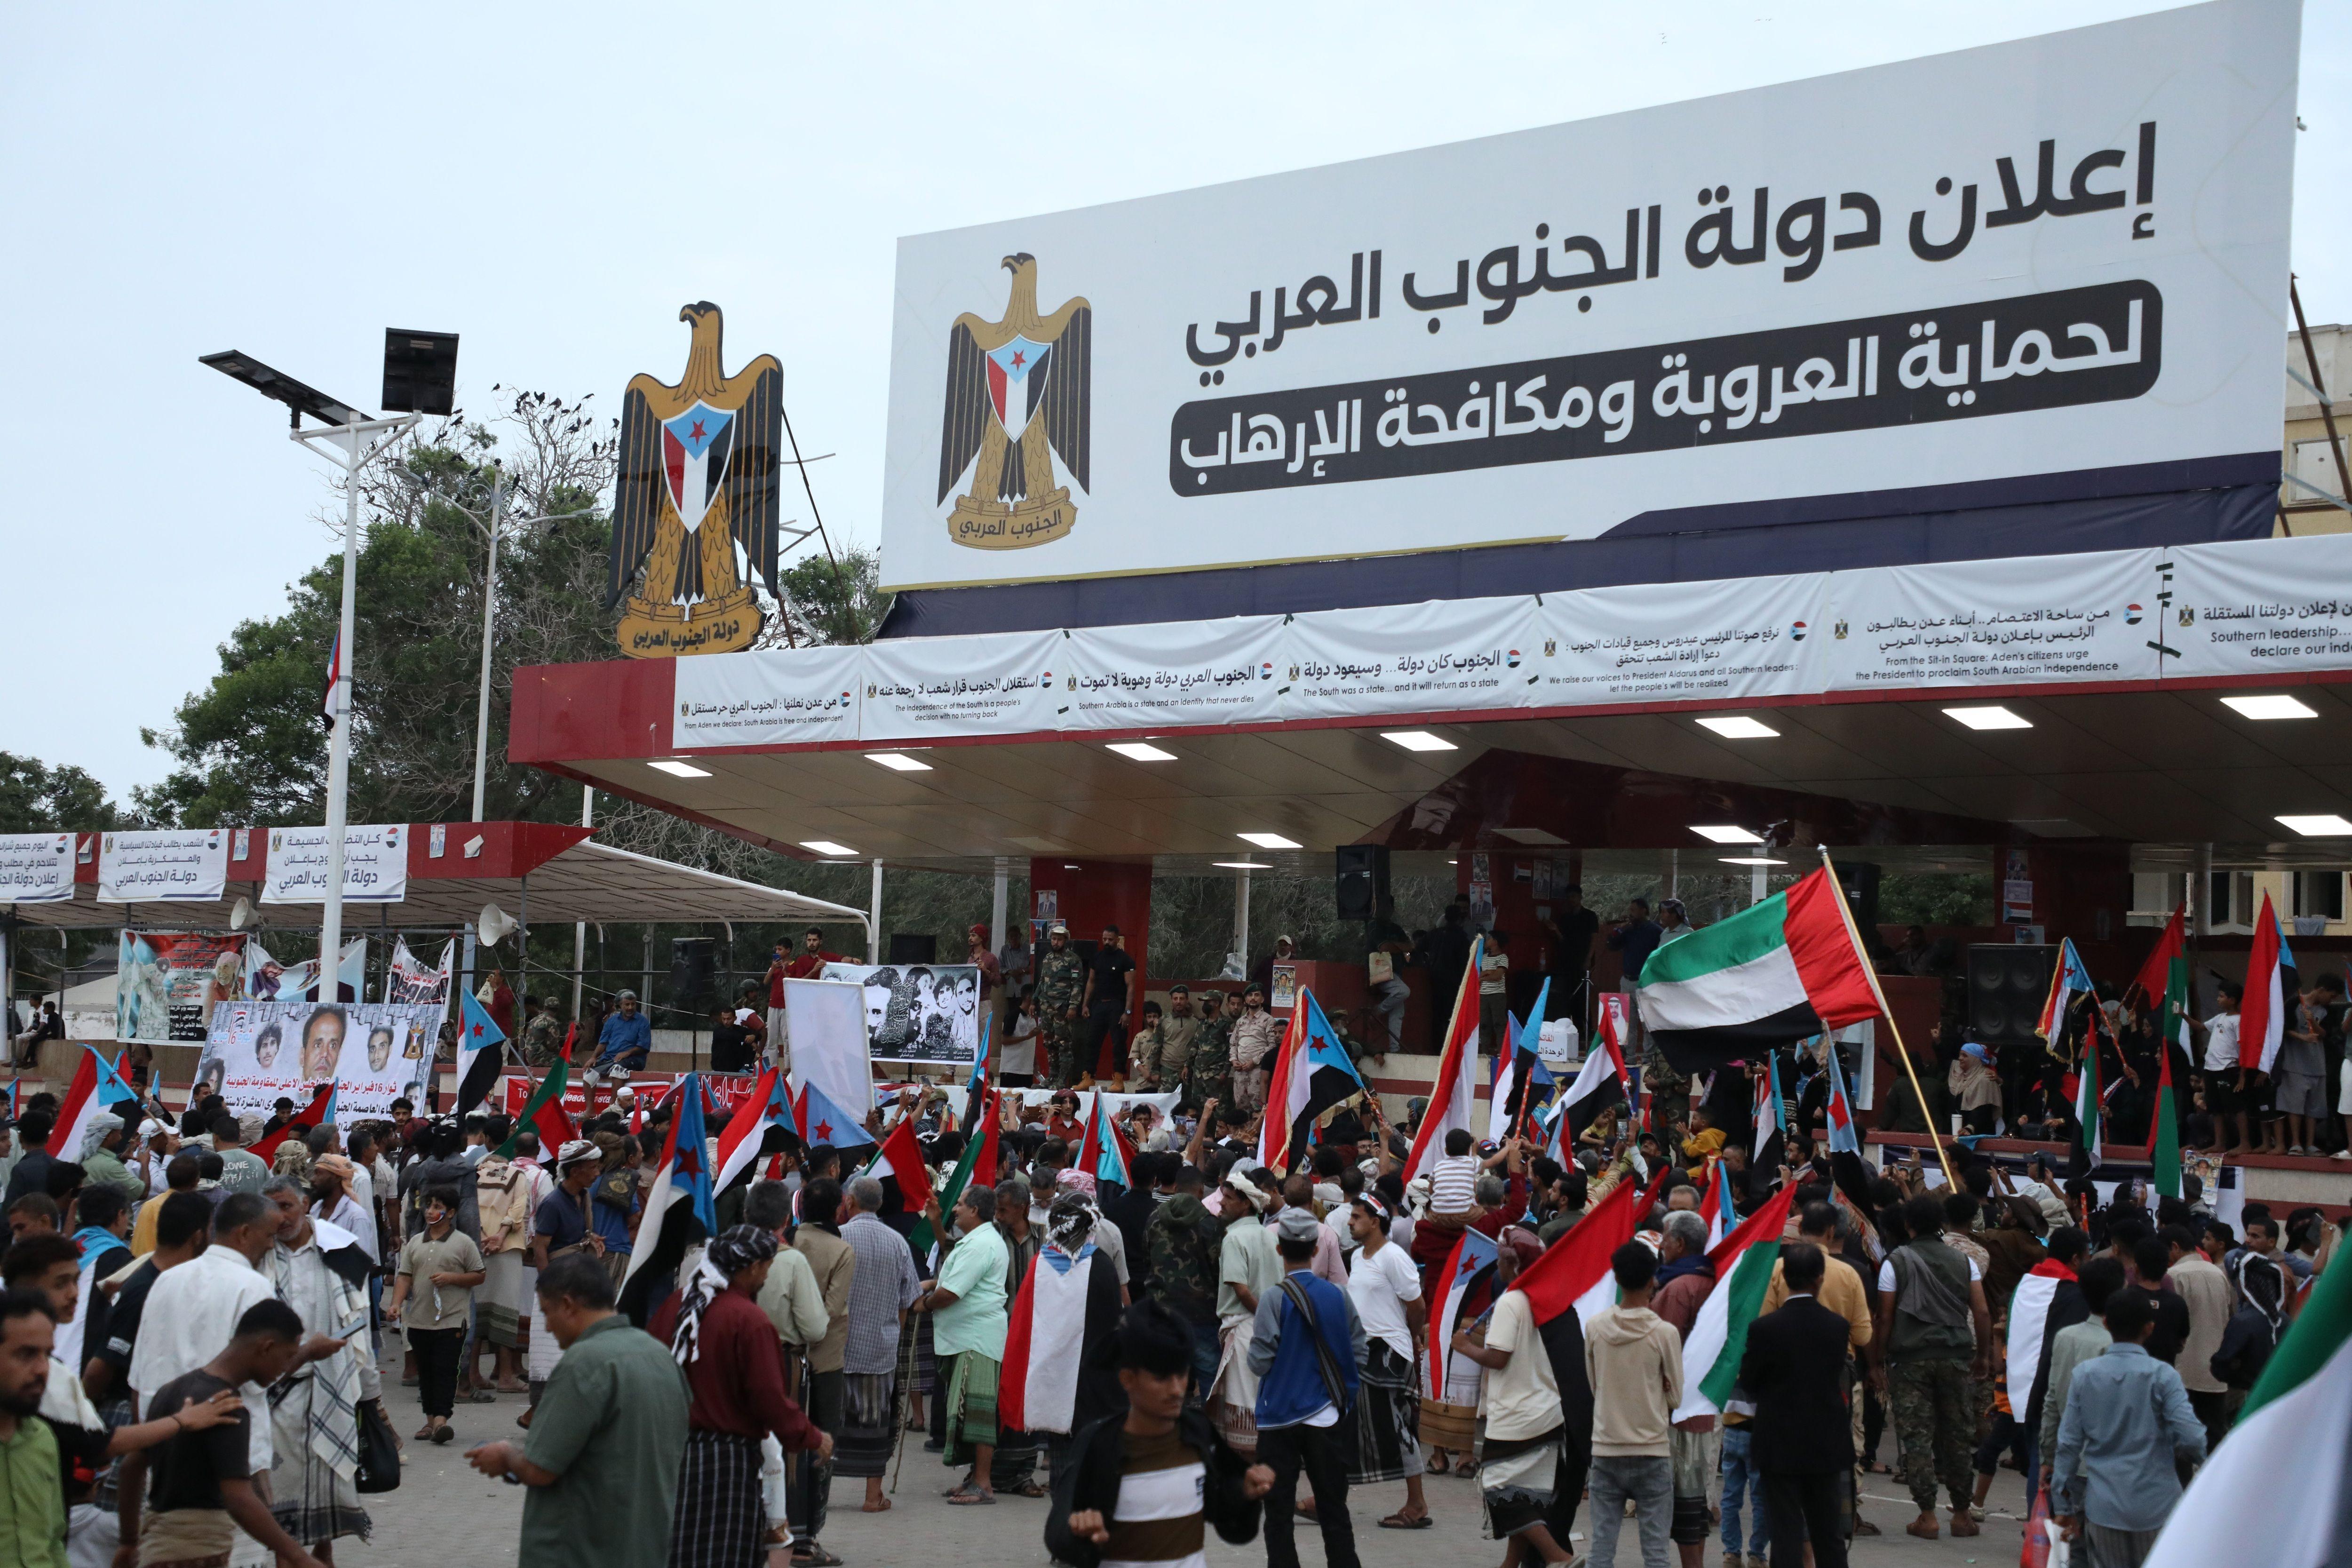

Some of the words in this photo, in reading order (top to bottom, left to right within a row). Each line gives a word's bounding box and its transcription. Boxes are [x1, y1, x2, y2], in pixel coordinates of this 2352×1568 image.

[1908, 121, 2156, 262] إعلان
[1685, 185, 1882, 282] دولة
[1402, 204, 1661, 334] الجنوب
[1185, 249, 1382, 386] العربي
[1898, 299, 2143, 407] لحماية
[1652, 335, 1879, 434] العروبة
[1376, 374, 1635, 447] ومكافحة
[1180, 398, 1361, 485] الإرهاب
[959, 519, 1006, 539] العربي
[1011, 508, 1062, 540] الجنوب
[2046, 608, 2083, 621] ساحة
[2086, 610, 2110, 622] من
[2203, 605, 2255, 620] المستقلة
[2259, 604, 2295, 620] دولتنا
[2298, 600, 2338, 619] لإعلان
[1867, 617, 1916, 632] يطالبون
[1919, 618, 1946, 629] عدن
[1949, 610, 1975, 628] أبناء
[1986, 610, 2043, 625] الاعتصام
[712, 619, 739, 642] دولة
[1700, 630, 1732, 645] للرئيس
[1734, 630, 1759, 643] صوتنا
[1762, 626, 1780, 643] نرفع
[1972, 631, 1999, 645] دولة
[2001, 629, 2042, 645] بإعلان
[2046, 625, 2094, 643] الرئيس
[2210, 630, 2266, 643] Southern
[633, 628, 669, 649] العربي
[670, 625, 710, 653] الجنوب
[1571, 639, 1601, 653] الجنوب
[1603, 636, 1631, 650] قيادات
[1633, 639, 1660, 651] وجميع
[1662, 636, 1698, 648] عيدروس
[1879, 634, 1921, 653] العربي
[1924, 631, 1969, 648] الجنوب
[1646, 650, 1677, 665] الشعب
[1679, 649, 1699, 663] إرادة
[1701, 649, 1720, 662] دعوا
[1886, 658, 1908, 666] From
[1910, 656, 1924, 665] the
[1928, 655, 1950, 664] Sit-in
[1953, 654, 1988, 665] Square:
[1991, 652, 2025, 661] Aden's
[2027, 651, 2063, 660] citizens
[2066, 651, 2089, 660] urge
[2250, 645, 2301, 657] declare
[2305, 645, 2326, 654] our
[1427, 653, 1453, 674] كان
[1453, 650, 1500, 673] الجنوب
[1616, 653, 1645, 667] تتحقق
[1214, 665, 1255, 686] الجنوب
[1304, 661, 1330, 681] دولة
[1334, 662, 1382, 680] وسيعود
[1632, 671, 1667, 680] President
[1669, 668, 1697, 677] Aidarus
[1728, 666, 1763, 675] Southern
[1764, 664, 1794, 672] leaders
[1856, 671, 1870, 680] the
[1873, 669, 1916, 679] President
[1928, 668, 1971, 679] proclaim
[1973, 666, 1999, 676] South
[2002, 664, 2041, 675] Arabian
[2044, 662, 2119, 674] independence
[969, 677, 1001, 695] الجنوب
[1002, 675, 1038, 692] استقلال
[1081, 674, 1109, 692] تموت
[1112, 672, 1119, 686] لا
[1121, 672, 1151, 691] وهوية
[1154, 671, 1178, 688] دولة
[1180, 669, 1212, 692] العربي
[1635, 683, 1668, 692] people's
[1696, 679, 1728, 688] realized
[879, 686, 894, 696] عنه
[895, 683, 915, 699] رجعة
[918, 682, 924, 695] لا
[926, 681, 950, 698] شعب
[952, 678, 967, 696] قرار
[1304, 688, 1317, 697] The
[1319, 687, 1339, 696] South
[1366, 685, 1392, 693] state...
[1394, 683, 1410, 692] and
[1419, 682, 1431, 690] will
[1434, 681, 1456, 689] return
[1478, 678, 1499, 687] state
[691, 703, 717, 716] مستقل
[718, 704, 728, 715] حر
[729, 700, 749, 717] العربي
[751, 699, 777, 714] الجنوب
[784, 697, 803, 711] نعلنها
[805, 700, 823, 711] عدن
[824, 699, 837, 710] من
[906, 703, 947, 712] independence
[996, 699, 1021, 708] people's
[1180, 697, 1204, 707] identity
[808, 715, 843, 724] independent
[915, 713, 939, 721] decision
[961, 711, 981, 720] turning
[14, 843, 30, 853] جميع
[31, 841, 48, 852] اليوم
[119, 841, 144, 852] السياسية
[145, 840, 162, 851] قيادتنا
[163, 840, 181, 850] يطالب
[183, 837, 204, 850] الشعب
[3, 858, 23, 870] مطلب
[24, 858, 34, 872] في
[35, 858, 57, 869] تتلاحم
[284, 854, 318, 867] بإعلان
[351, 853, 378, 865] يجب
[14, 872, 33, 887] دولة
[35, 872, 58, 888] إعلان
[115, 871, 139, 891] العربي
[140, 870, 169, 885] الجنوب
[170, 869, 197, 884] دولة
[279, 870, 310, 894] العربي
[351, 868, 378, 887] دولة
[518, 1088, 528, 1098] To
